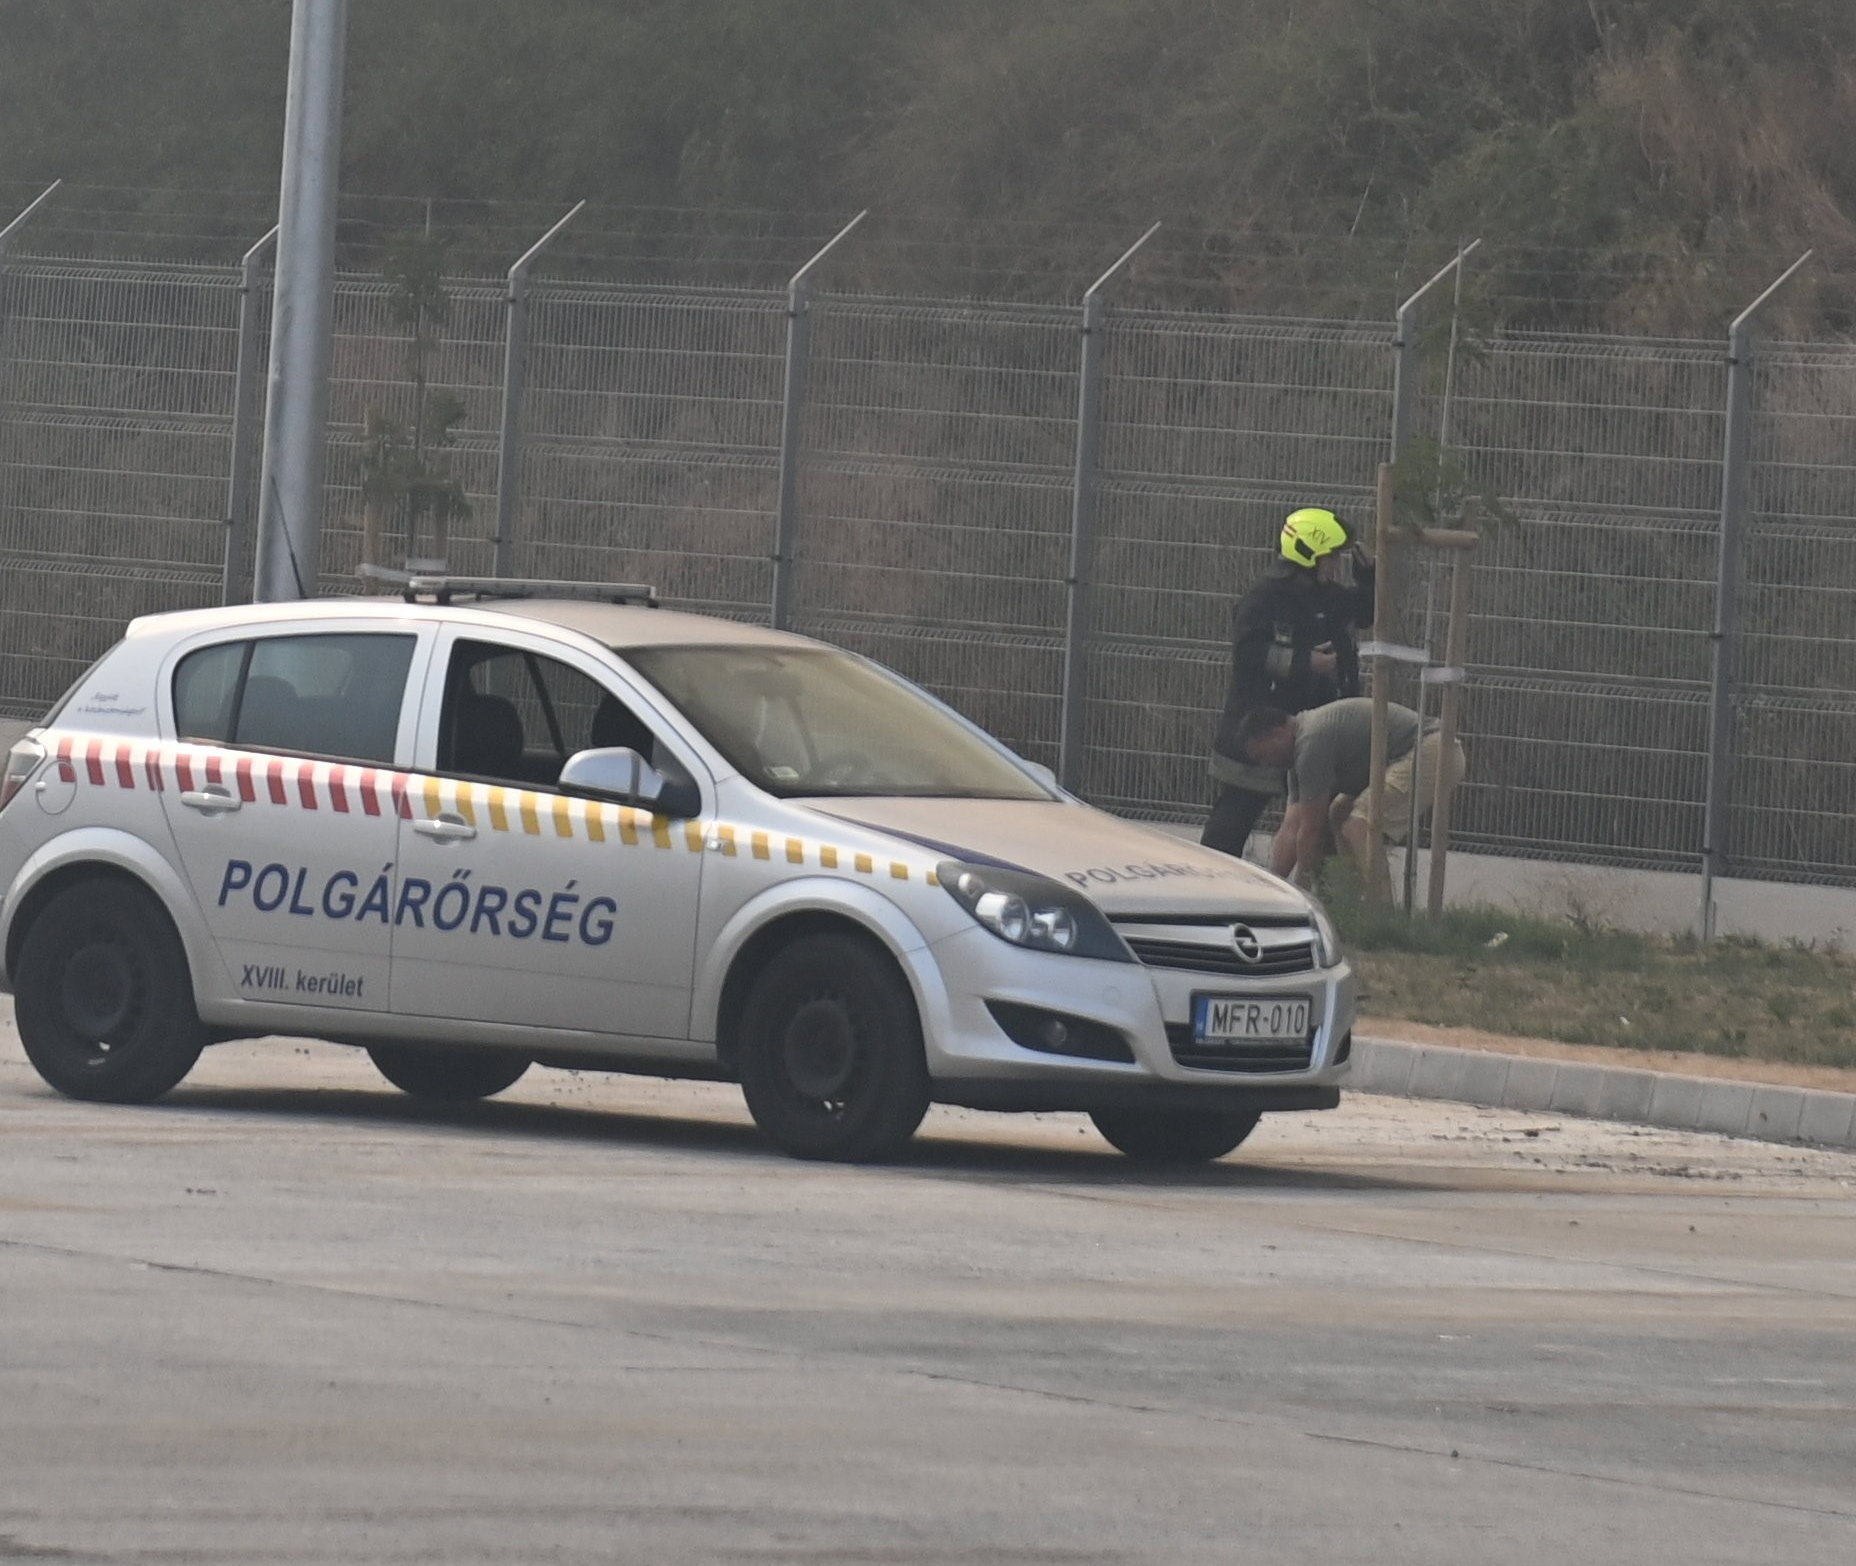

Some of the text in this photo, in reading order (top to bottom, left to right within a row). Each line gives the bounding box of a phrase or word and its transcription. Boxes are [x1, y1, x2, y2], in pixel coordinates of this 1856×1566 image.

[217, 859, 618, 946] POLGÁRŐRSÉG
[241, 964, 363, 997] XVIII. kerület
[1211, 1003, 1305, 1034] MFR-010
